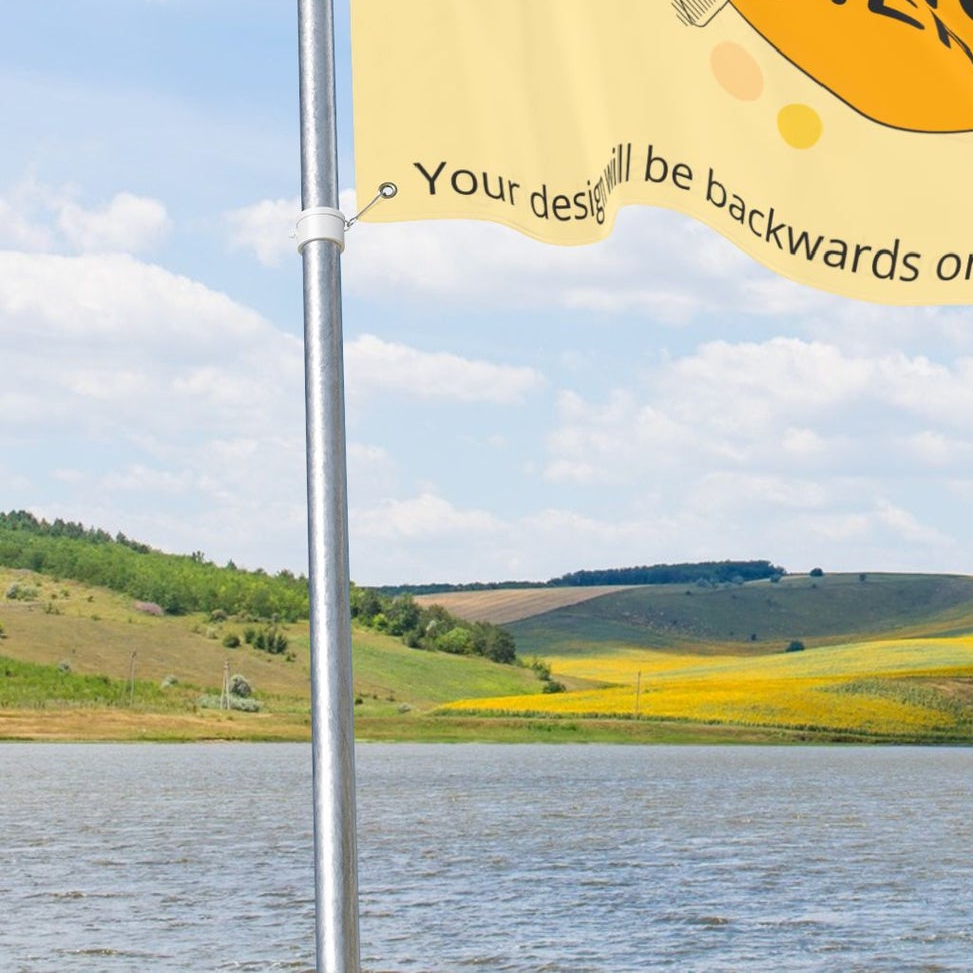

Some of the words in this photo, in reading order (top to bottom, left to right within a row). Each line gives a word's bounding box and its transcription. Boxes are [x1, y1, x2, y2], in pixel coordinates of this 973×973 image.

[412, 161, 521, 206] Your
[530, 178, 608, 225] design
[603, 142, 632, 196] will
[644, 144, 694, 191] be
[705, 167, 921, 283] backwards
